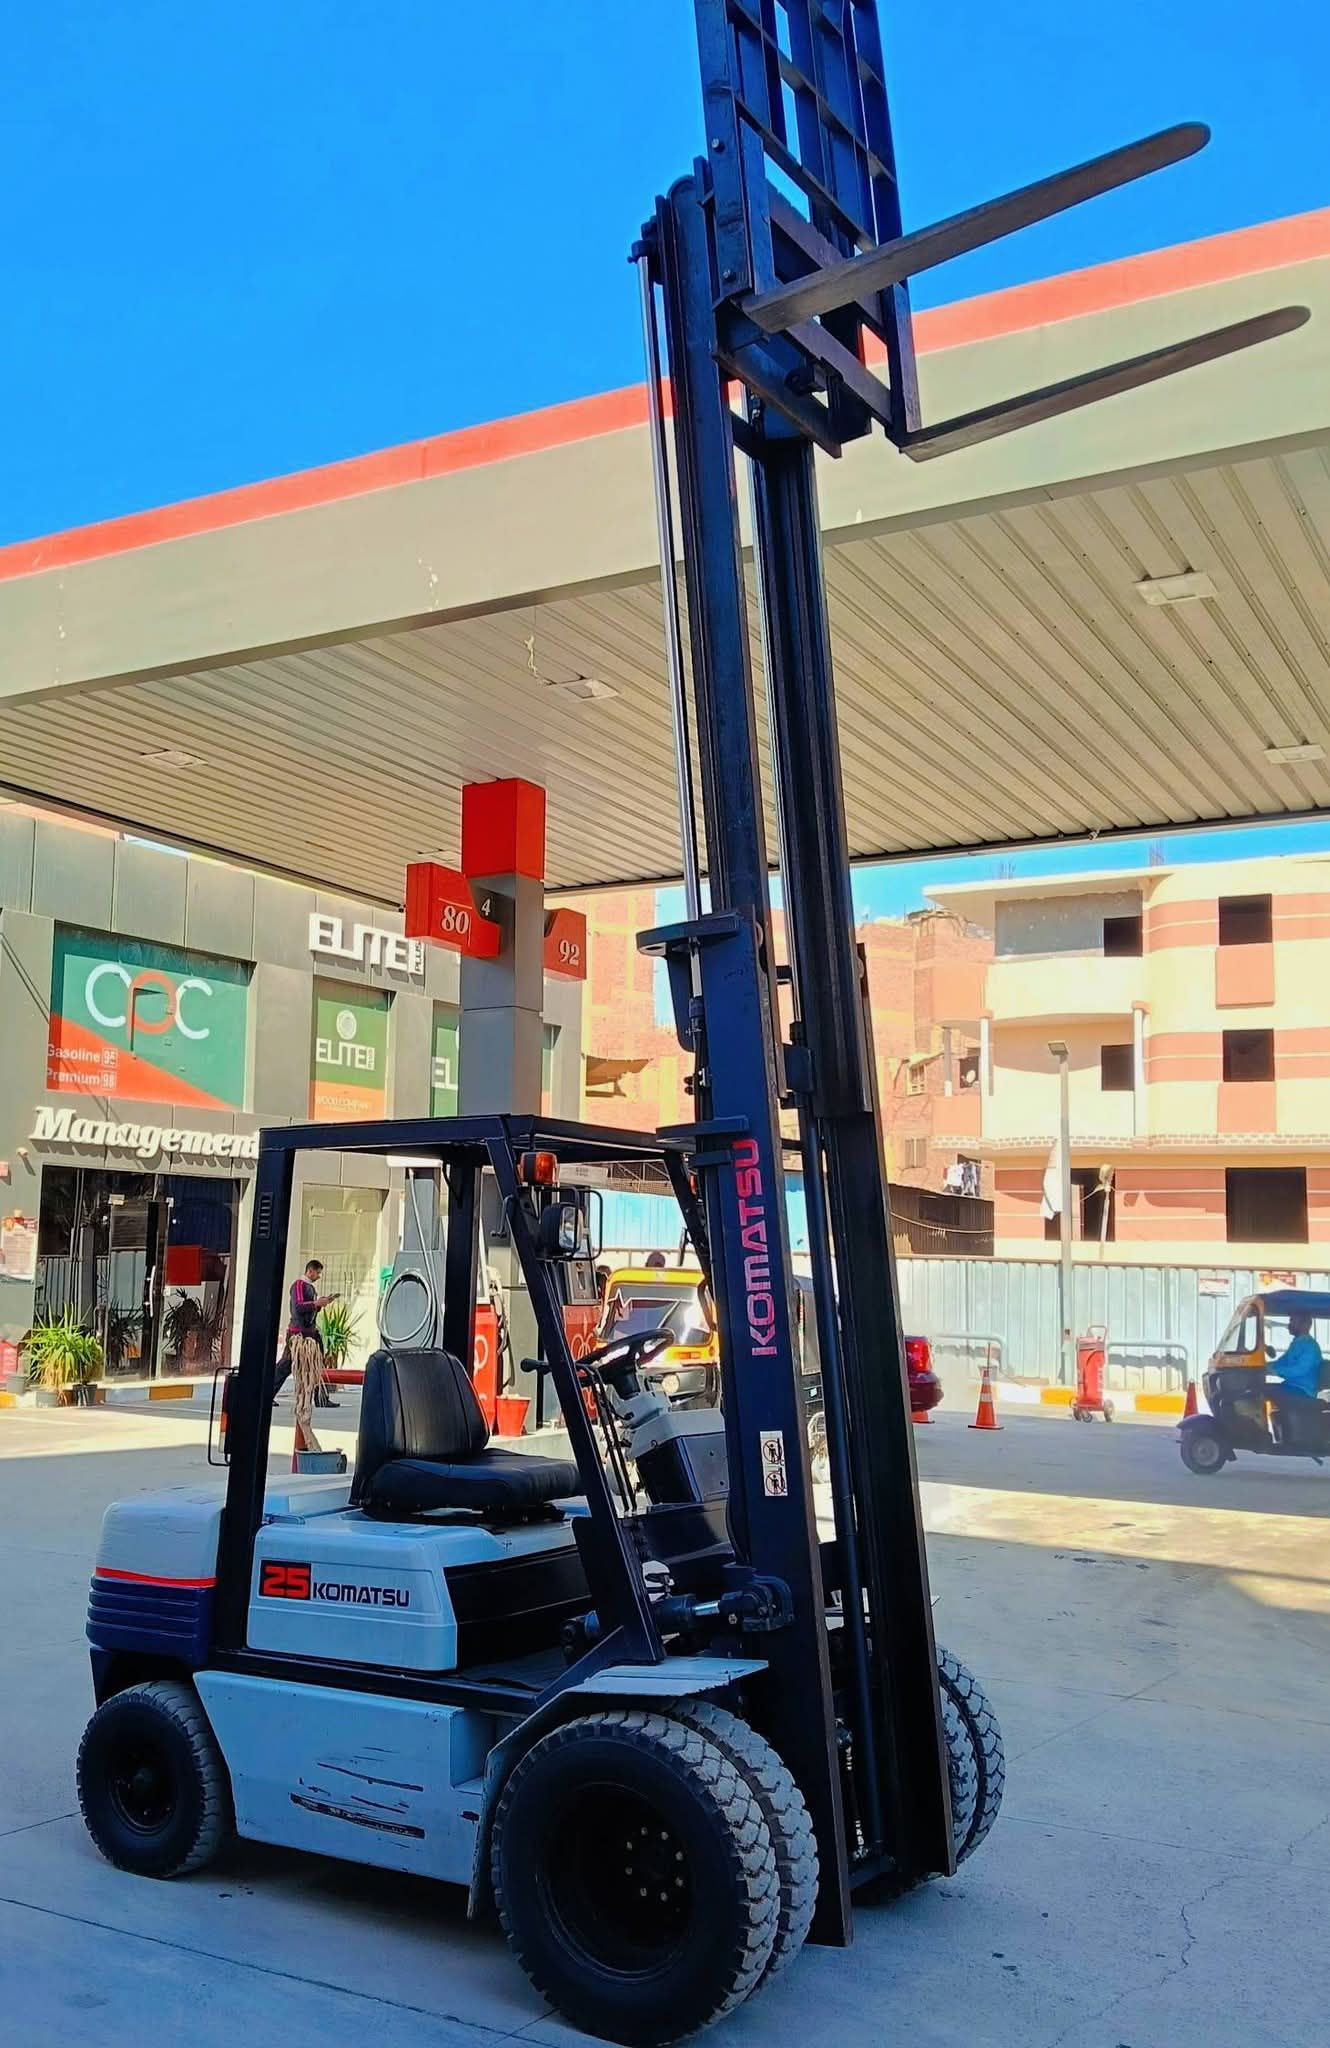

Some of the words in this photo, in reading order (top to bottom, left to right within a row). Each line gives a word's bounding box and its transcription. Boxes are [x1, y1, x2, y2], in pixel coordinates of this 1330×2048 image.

[441, 905, 469, 935] 80
[481, 898, 491, 916] 4
[309, 912, 409, 973] ELITE
[559, 939, 580, 966] 92
[47, 1044, 100, 1063] Gasoline
[316, 1037, 368, 1069] ELITE
[47, 1067, 100, 1086] Premium
[732, 1138, 778, 1356] KOMATSU
[263, 1564, 310, 1599] 25
[313, 1582, 410, 1607] KOMATSU
